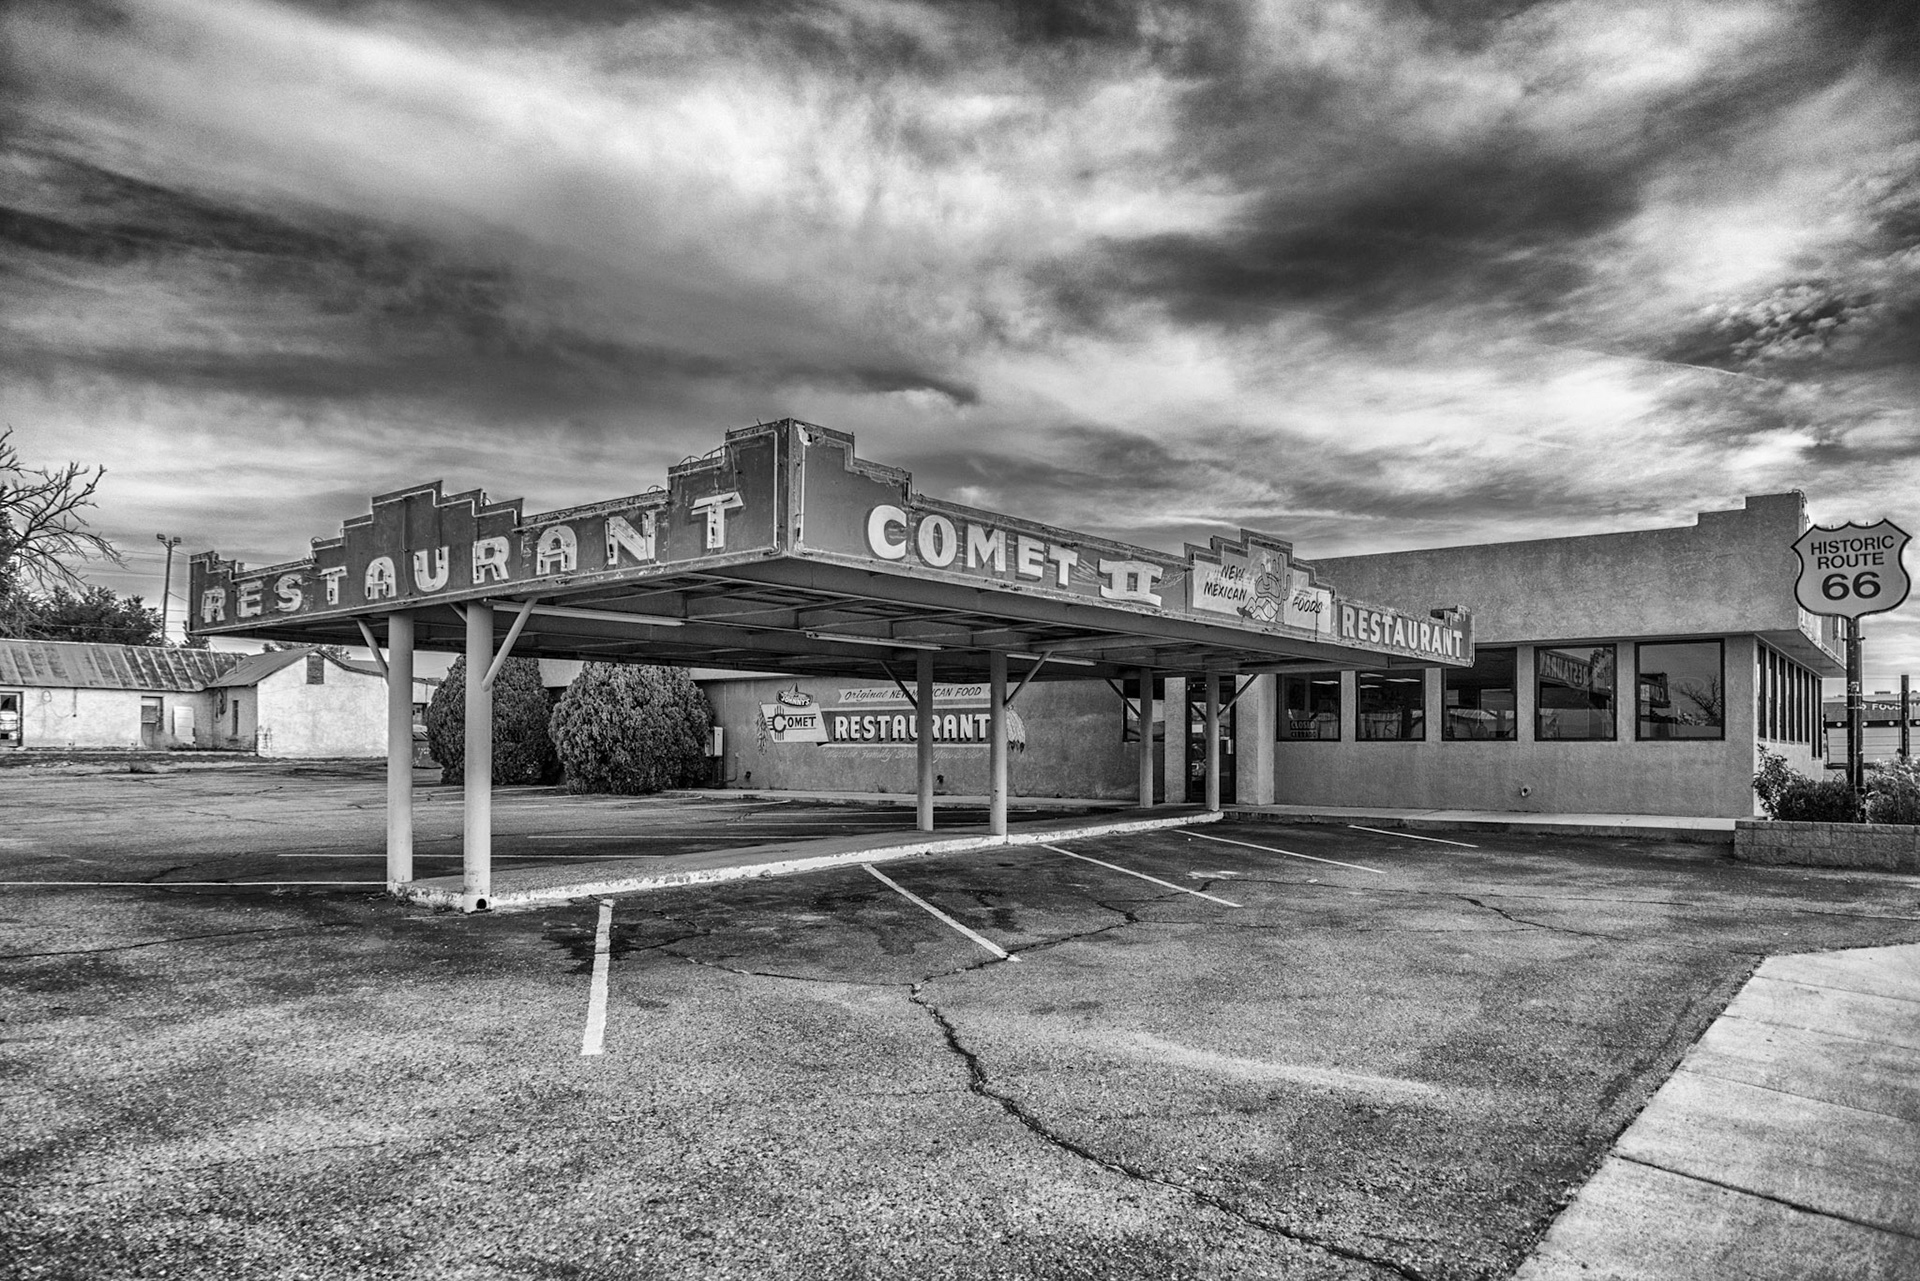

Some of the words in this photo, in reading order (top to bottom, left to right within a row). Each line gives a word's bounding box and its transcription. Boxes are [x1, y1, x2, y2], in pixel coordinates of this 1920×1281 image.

[867, 504, 1078, 587] COMET
[1098, 557, 1164, 607] II
[1811, 535, 1895, 555] HISTORIC
[201, 491, 744, 624] RESTAURANT
[1817, 552, 1885, 569] ROUTE
[1220, 563, 1246, 580] NEW
[1203, 581, 1248, 602] MEXICAN
[1822, 571, 1881, 601] 66
[1293, 596, 1323, 613] FOODS
[1342, 605, 1463, 658] RESTAURANT
[844, 689, 888, 701] Original
[911, 688, 953, 698] MCAN
[955, 686, 982, 698] FOOD
[770, 713, 817, 734] COMET
[834, 713, 992, 741] RESTAURANT
